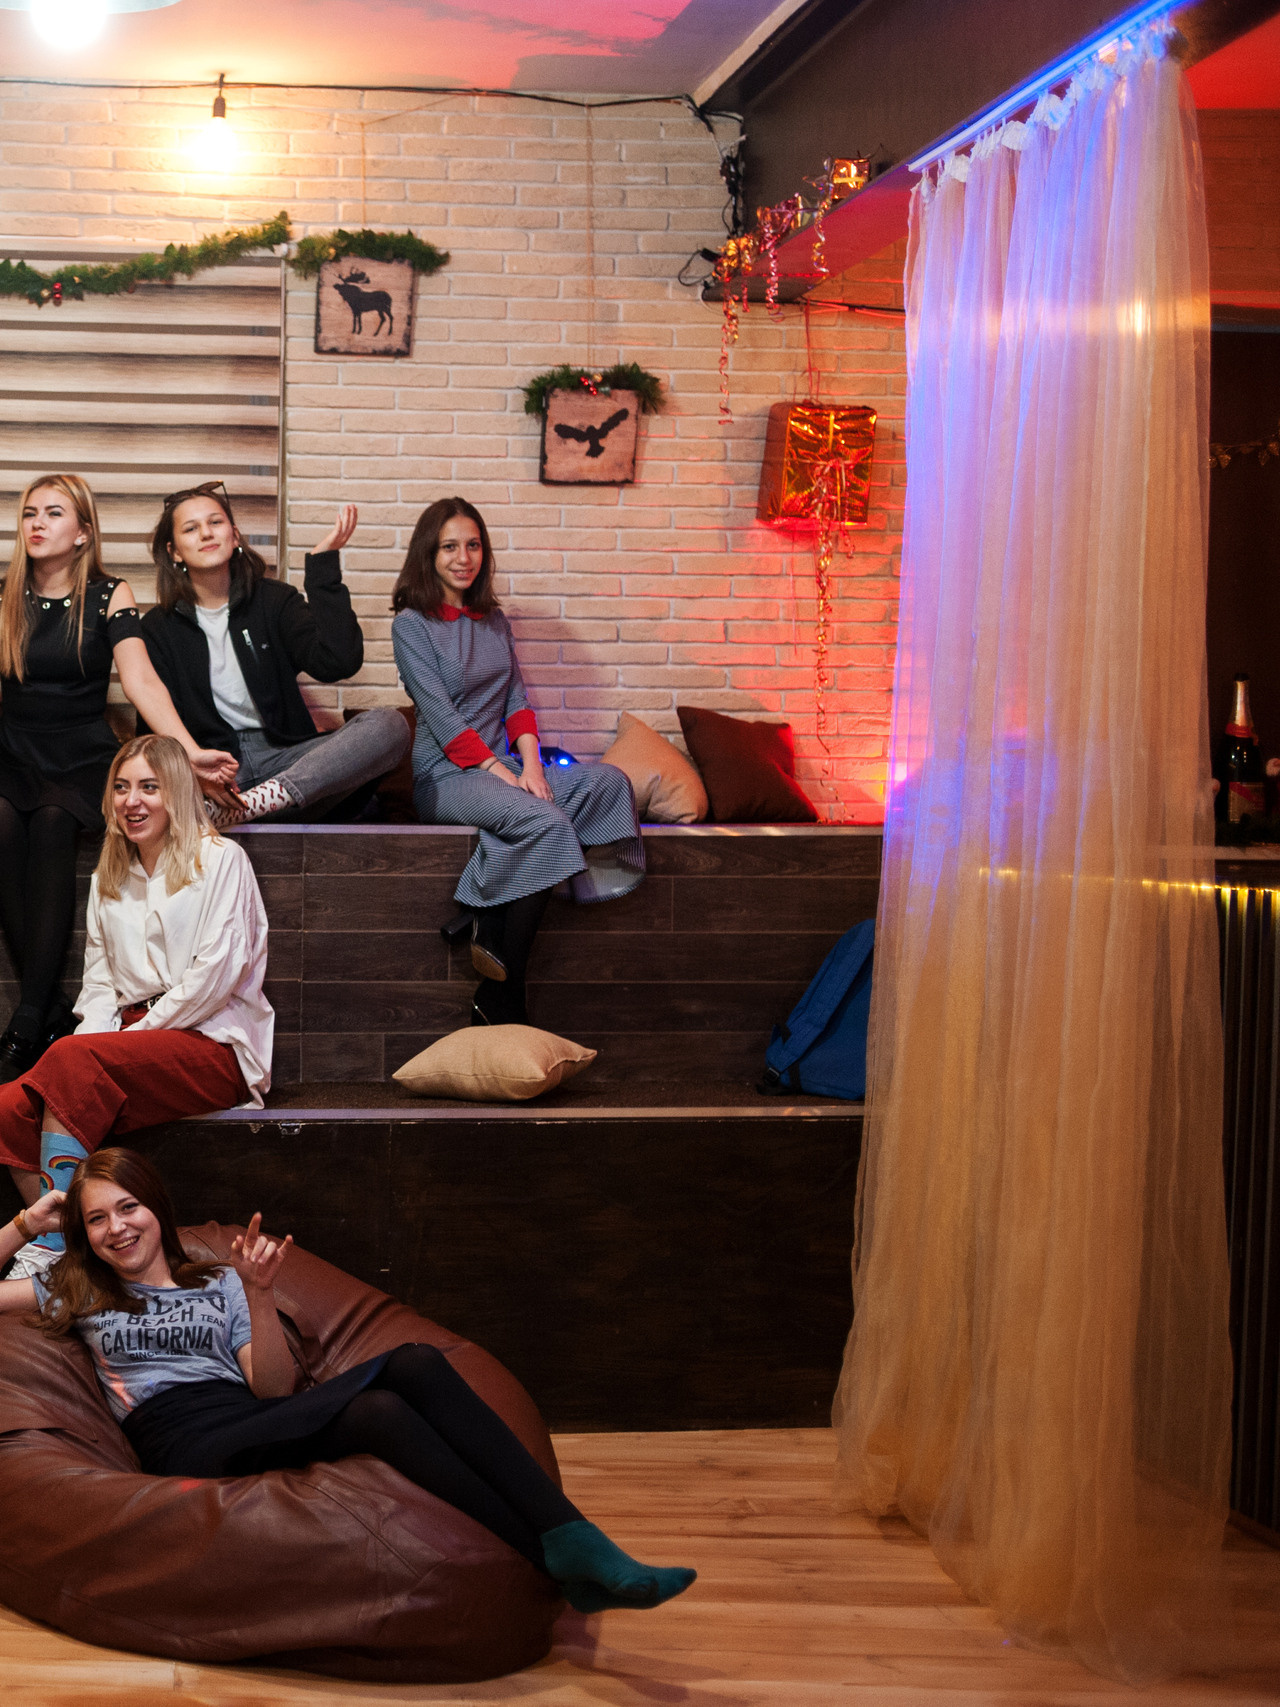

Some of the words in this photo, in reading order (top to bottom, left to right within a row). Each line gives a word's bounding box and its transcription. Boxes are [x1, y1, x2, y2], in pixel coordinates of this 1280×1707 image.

[126, 1305, 194, 1327] BEACH
[200, 1313, 226, 1329] TEAM
[101, 1326, 213, 1357] CALIFORNIA
